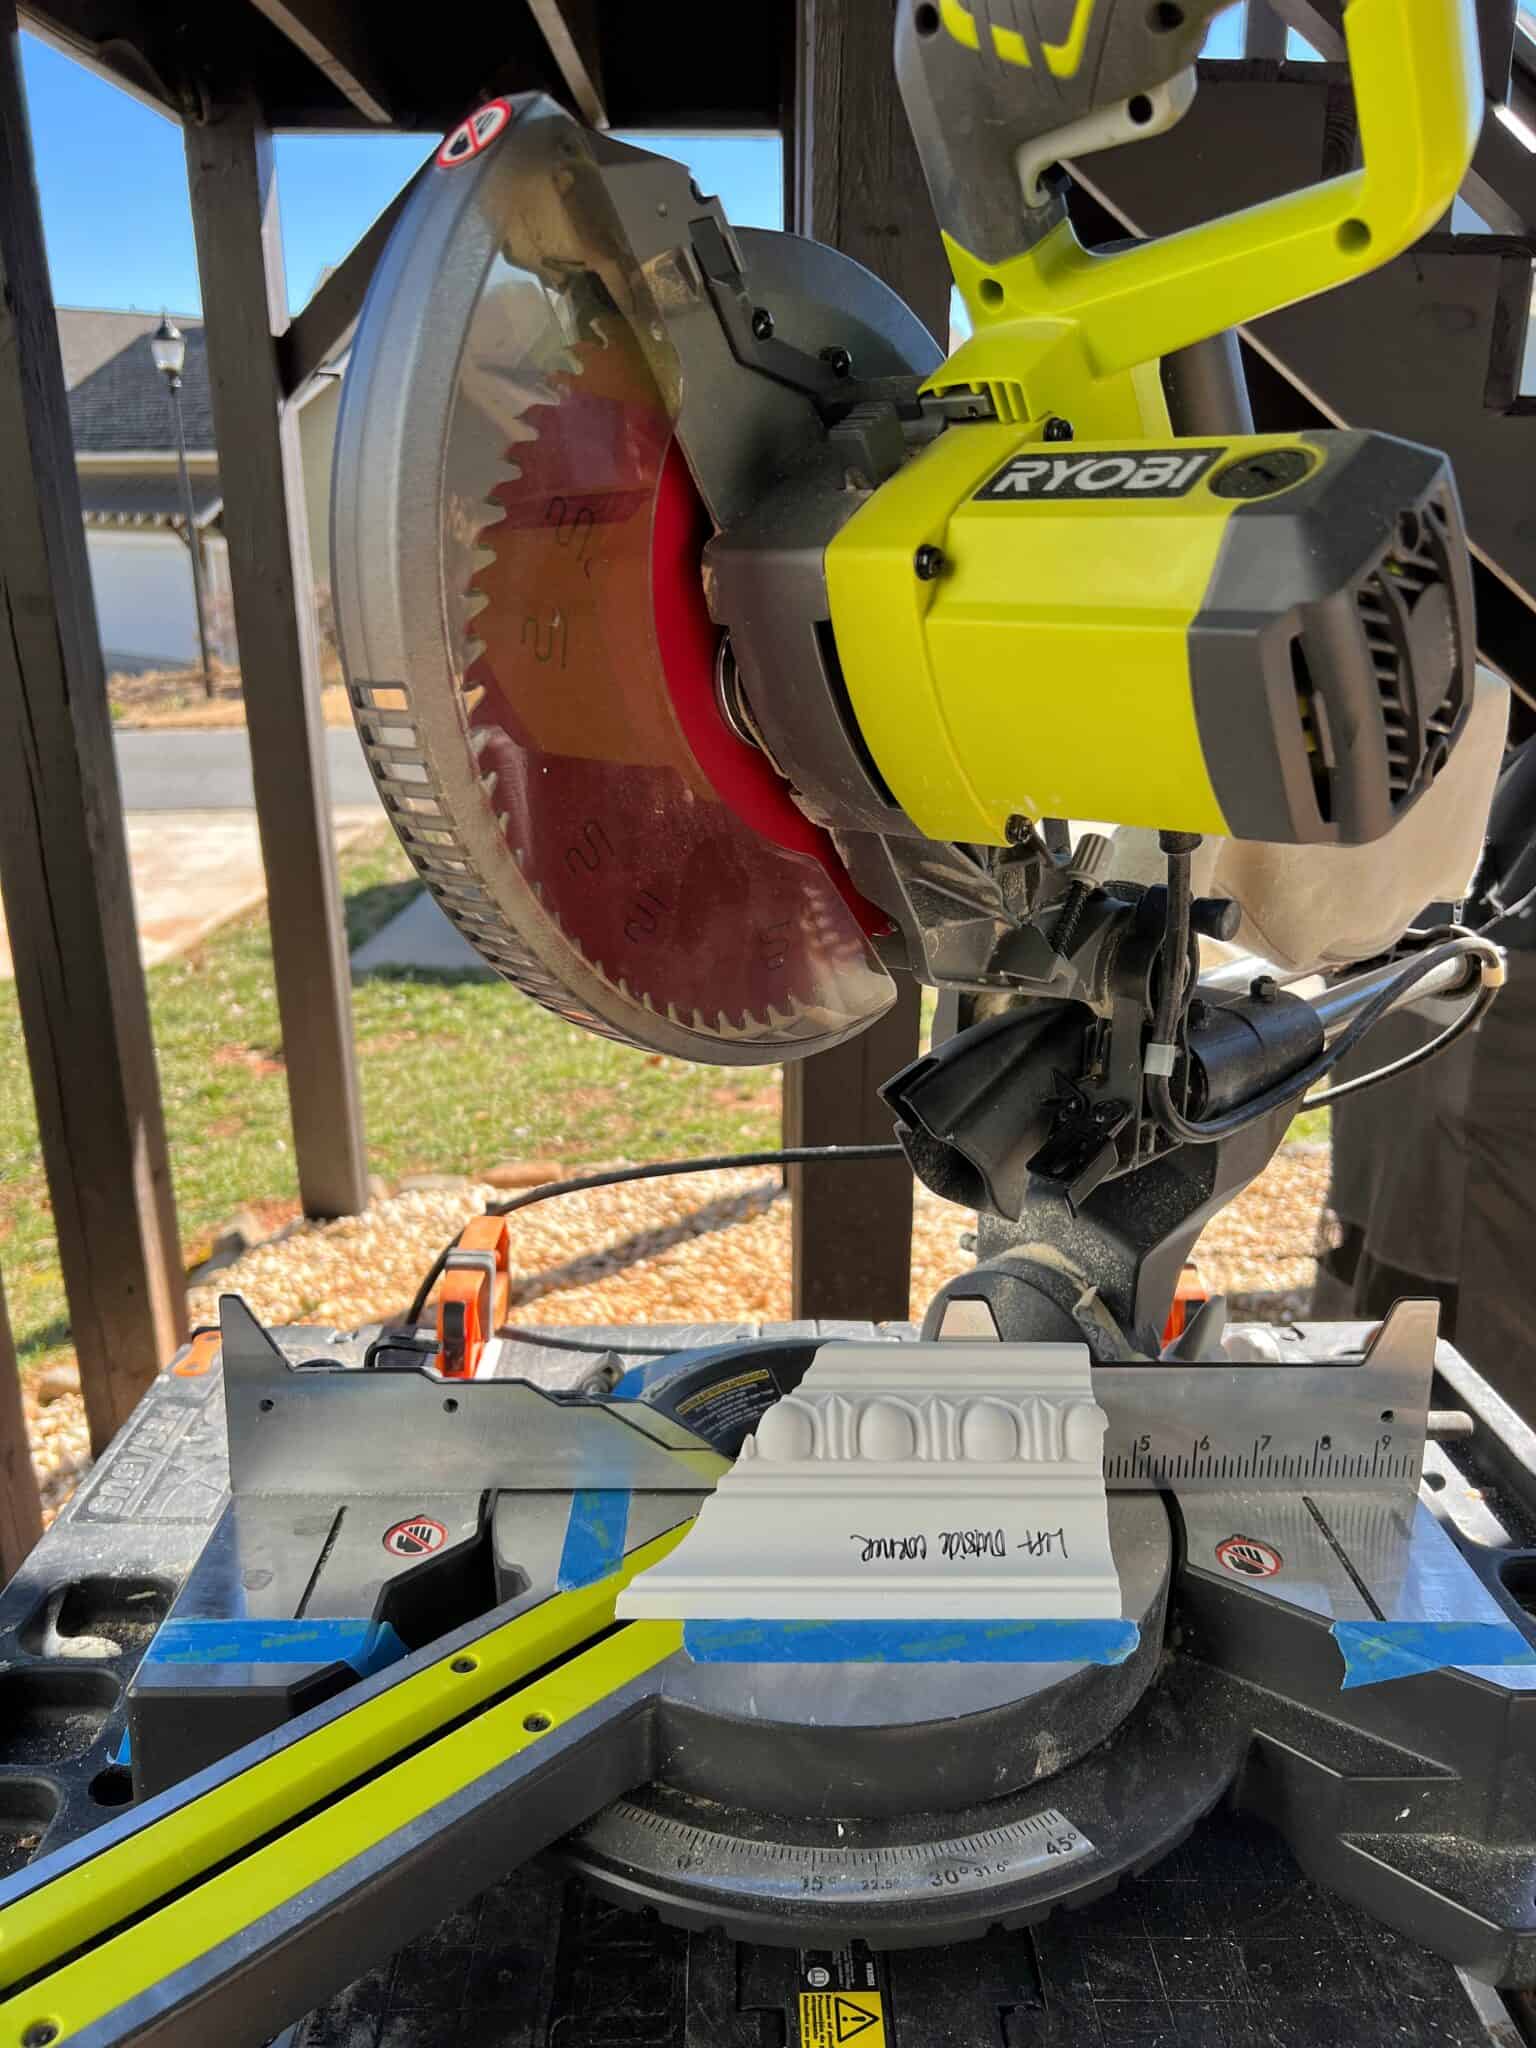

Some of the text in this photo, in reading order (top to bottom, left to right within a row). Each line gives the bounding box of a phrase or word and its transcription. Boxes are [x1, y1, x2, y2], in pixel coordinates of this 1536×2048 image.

[992, 456, 1209, 492] RYOBI
[1139, 1434, 1392, 1451] 5 6 7 8 9
[1046, 1832, 1078, 1857] 45°
